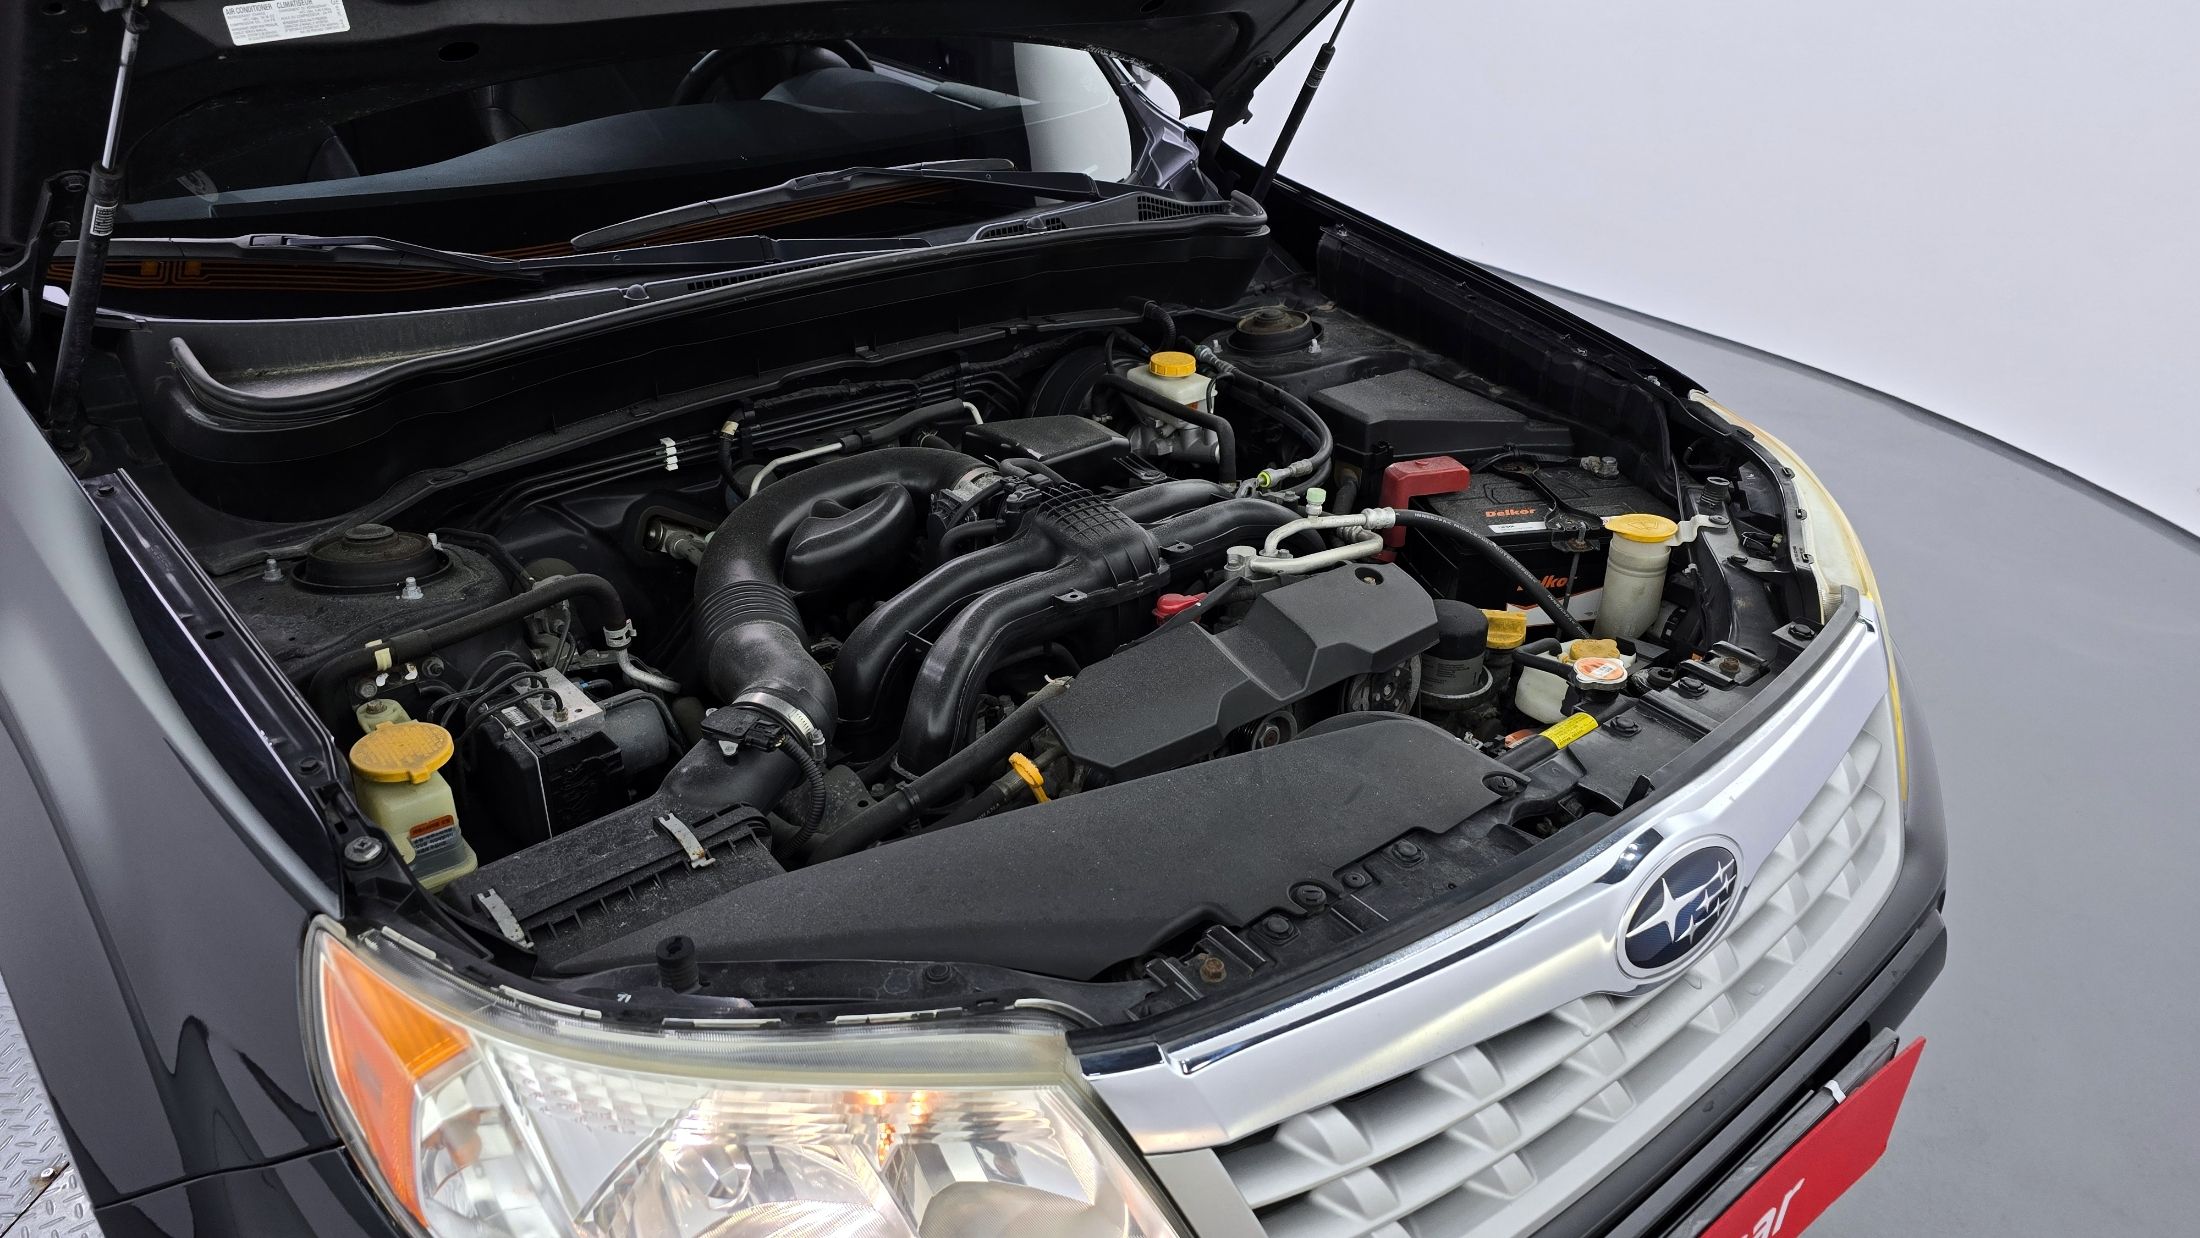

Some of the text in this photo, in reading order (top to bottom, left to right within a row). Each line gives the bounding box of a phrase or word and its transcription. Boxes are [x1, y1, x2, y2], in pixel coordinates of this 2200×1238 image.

[225, 7, 236, 16] AIR
[237, 2, 273, 15] CONDITIONER
[1484, 508, 1537, 518] Delkor
[1741, 1176, 1805, 1238] ar
